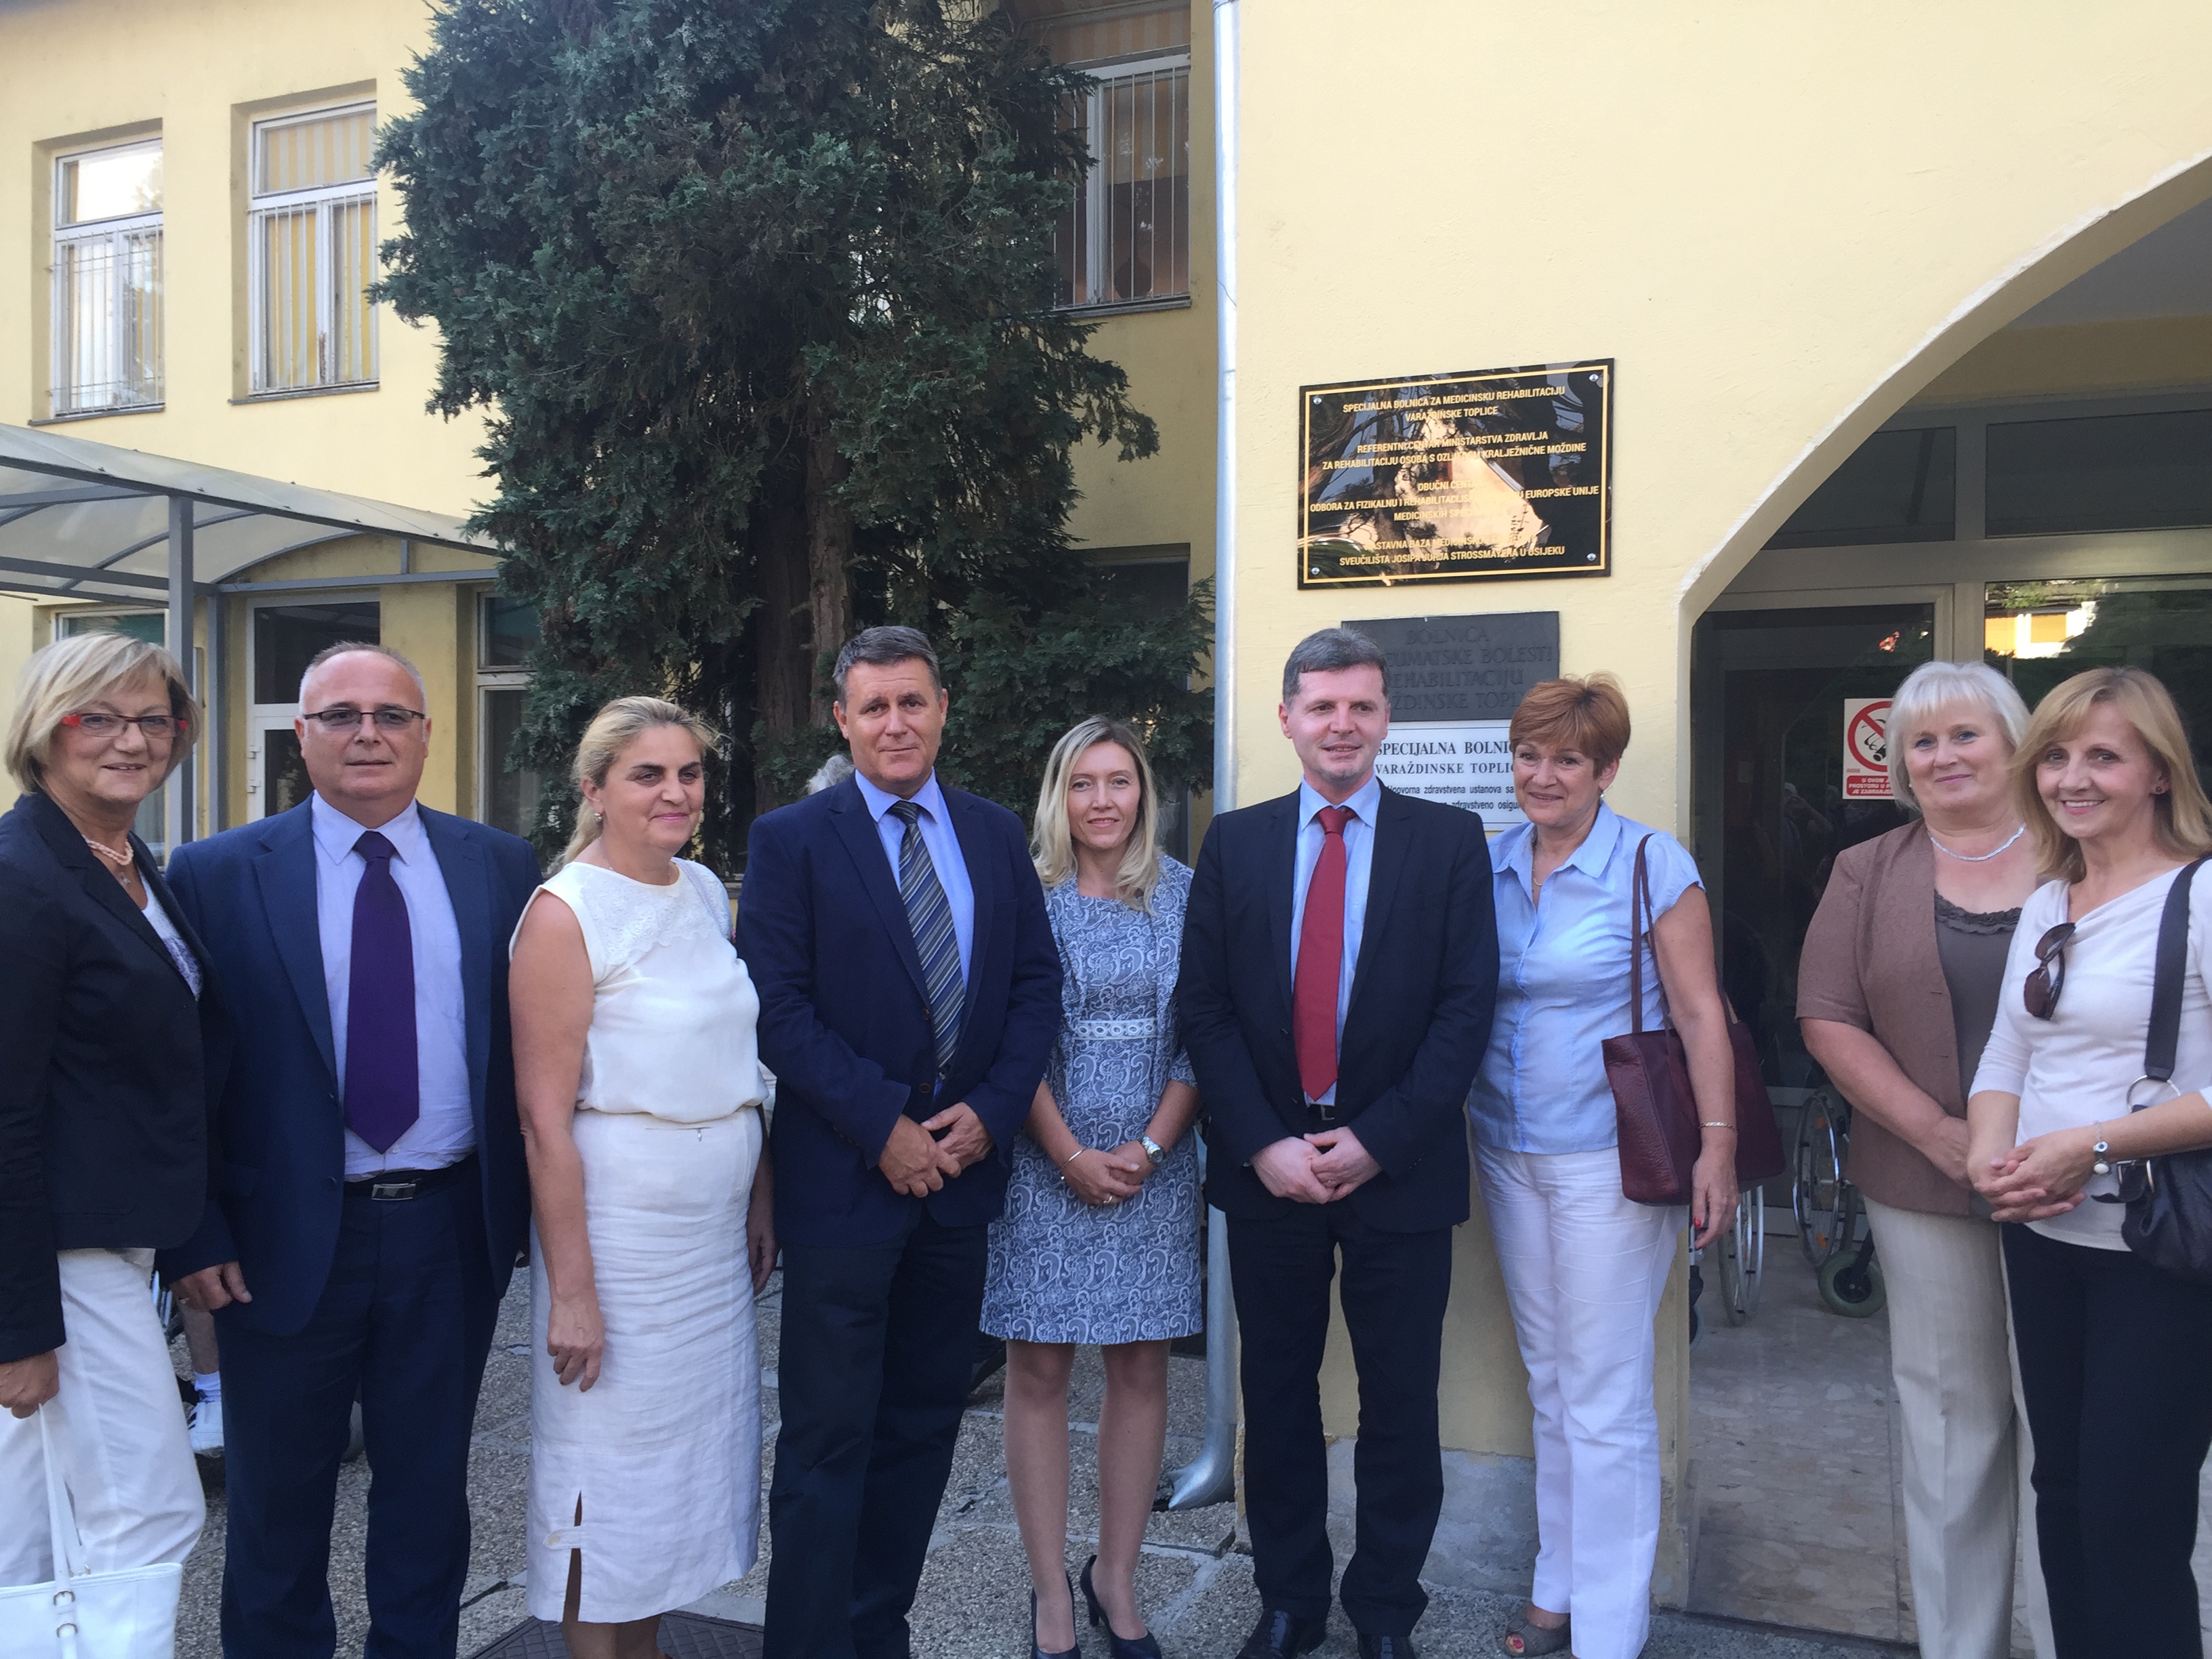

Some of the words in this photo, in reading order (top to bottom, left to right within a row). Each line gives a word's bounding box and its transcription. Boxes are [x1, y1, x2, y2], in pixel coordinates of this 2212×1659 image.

[1343, 399, 1392, 413] SPECIJALNA
[1393, 397, 1429, 409] BOLNICA
[1430, 396, 1441, 405] ZA
[1443, 391, 1495, 405] MEDICINSKU
[1496, 386, 1565, 401] REHABILITACIJU
[1464, 406, 1498, 417] TOPLICE
[1357, 442, 1407, 453] REFERENTNI
[1441, 435, 1503, 447] MINISTARSTVA
[1504, 431, 1549, 443] ZDRAVLJA
[1322, 462, 1333, 470] ZA
[1334, 457, 1399, 470] REHABILITACIJU
[1399, 455, 1427, 464] OSOBA
[1429, 453, 1435, 462] S
[1482, 445, 1546, 459] KRALJEŽNIČNE
[1547, 442, 1587, 454] MOŽDINE
[1417, 480, 1449, 491] OBUČNI
[1525, 487, 1572, 499] EUROPSKE
[1572, 485, 1599, 496] UNIJE
[1310, 501, 1343, 512] ODBORA
[1344, 500, 1355, 510] ZA
[1356, 498, 1398, 510] FIZIKALNU
[1399, 498, 1403, 506] I
[1393, 509, 1448, 521] MEDICINSKIH
[1409, 539, 1431, 548] BAZA
[1339, 553, 1389, 566] SVEUČILIŠTA
[1392, 554, 1420, 563] JOSIPA
[1422, 552, 1450, 562] JURJA
[1450, 548, 1519, 560] STROSSMAYERA
[1519, 548, 1527, 556] U
[1528, 546, 1565, 556] OSIJEKU
[1406, 626, 1490, 644] BOLNICA
[1385, 649, 1474, 667] EUMATSKE
[1480, 646, 1553, 663] BOLESTI
[1392, 692, 1469, 710] ŽDINSKE
[1475, 692, 1520, 708] TOPL
[1465, 741, 1511, 754] BOLNI
[1375, 760, 1464, 775] VARAŽDINSKE
[1424, 785, 1465, 794] zdravstvena
[1469, 785, 1501, 794] ustanova
[1498, 800, 1519, 812] osigu
